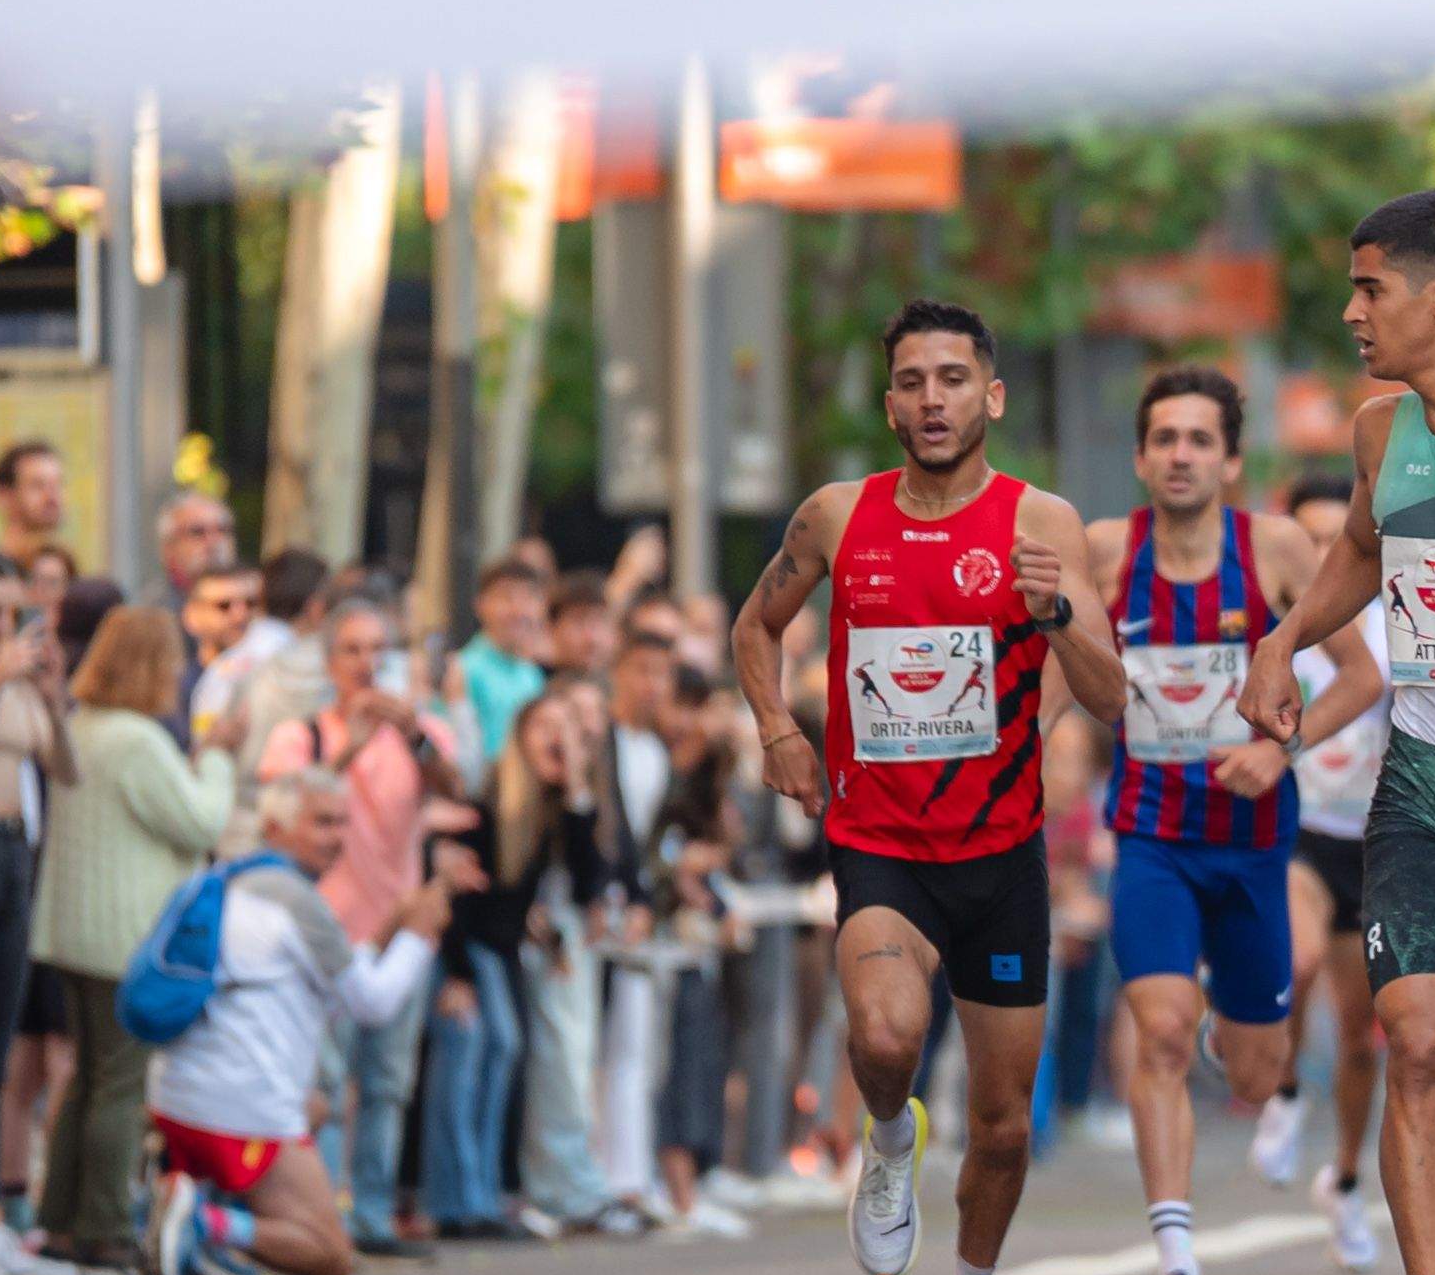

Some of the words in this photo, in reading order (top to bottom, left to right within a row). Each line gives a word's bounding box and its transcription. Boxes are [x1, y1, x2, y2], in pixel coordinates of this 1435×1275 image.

[950, 632, 982, 658] 24
[1209, 649, 1237, 674] 28
[870, 719, 975, 738] ORTIZ-RIVERA
